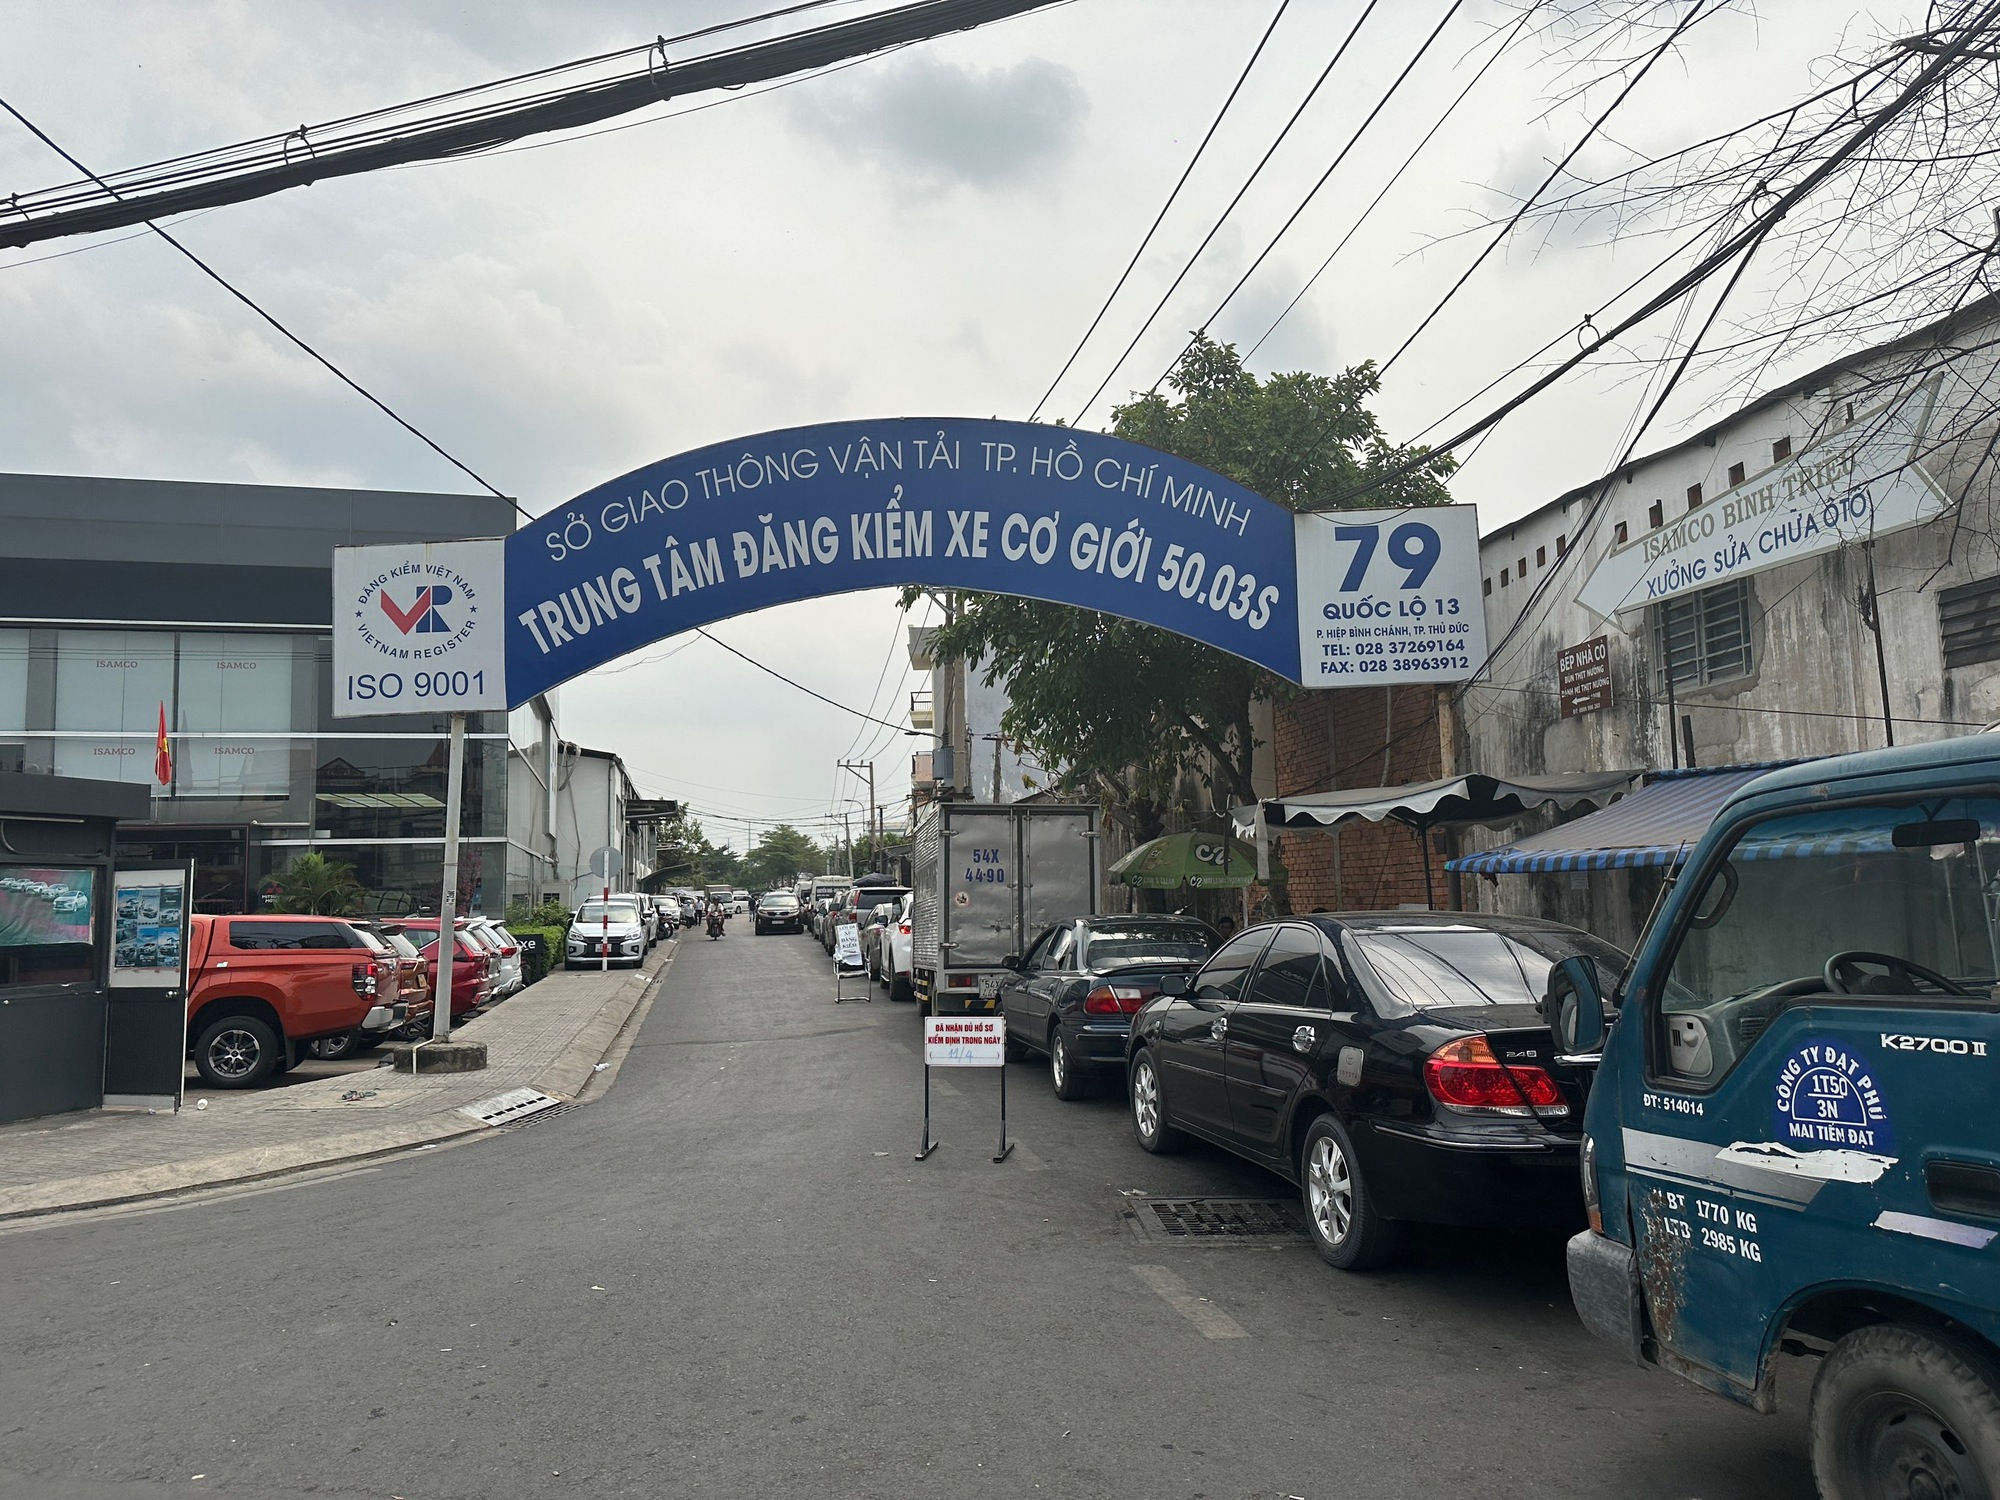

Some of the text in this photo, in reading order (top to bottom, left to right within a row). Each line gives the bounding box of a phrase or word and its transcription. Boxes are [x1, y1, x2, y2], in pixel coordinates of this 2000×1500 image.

[546, 430, 1251, 561] SỞ GIAO THÔNG VẬN TẢI TP. HỒ CHÍ MINH
[1642, 513, 1715, 563] ISAMCO
[1722, 484, 1775, 529] BÌNH
[1334, 522, 1441, 592] 79
[1646, 558, 1706, 599] XƯỞNG
[1714, 534, 1751, 573] SỬA
[1758, 508, 1820, 554] CHỮA
[518, 484, 1279, 654] TRUNG TÂM ĐĂNG KIỂM XE CƠ GIỚI 50.03S
[358, 560, 476, 604] ĐĂNG KIỂM VIỆT NAM
[1322, 594, 1460, 621] QUỐC LỘ 13
[358, 620, 476, 659] VIETNAM REGISTER
[1316, 621, 1470, 640] P. HIỆP BÌNH CHÁNH, TP. THỦ ĐỨC
[1322, 639, 1465, 656] TEL: 028 37269164
[96, 660, 138, 669] ISAMCO
[216, 661, 257, 669] ISAMCO
[1320, 656, 1469, 674] FAX: 028 38963912
[1560, 651, 1575, 673] BẾP
[1576, 644, 1594, 668] NHÀ
[348, 670, 484, 700] ISO 9001
[94, 748, 135, 756] ISAMCO
[214, 747, 255, 755] ISAMCO
[973, 849, 999, 863] 54X
[1195, 844, 1232, 865] C2
[1131, 874, 1143, 887] C2
[1190, 875, 1202, 888] C2
[935, 1023, 944, 1032] ĐÃ
[945, 1023, 963, 1034] NHẬN
[964, 1022, 973, 1032] ĐỦ
[984, 1023, 994, 1032] SƠ
[928, 1034, 1001, 1046] KIỂM ĐỊNH TRONG NGÀY
[1880, 1033, 1968, 1054] K2700
[1776, 1046, 1887, 1120] CÔNG TY ĐẠT PHÚ
[1663, 1097, 1704, 1116] 514014
[1816, 1099, 1839, 1119] 3N
[1789, 1122, 1874, 1149] MAI TIẾN ĐẠT
[1695, 1199, 1729, 1225] 1770
[1735, 1209, 1758, 1234] KG
[1701, 1227, 1737, 1254] 2985
[1739, 1238, 1762, 1263] KG
